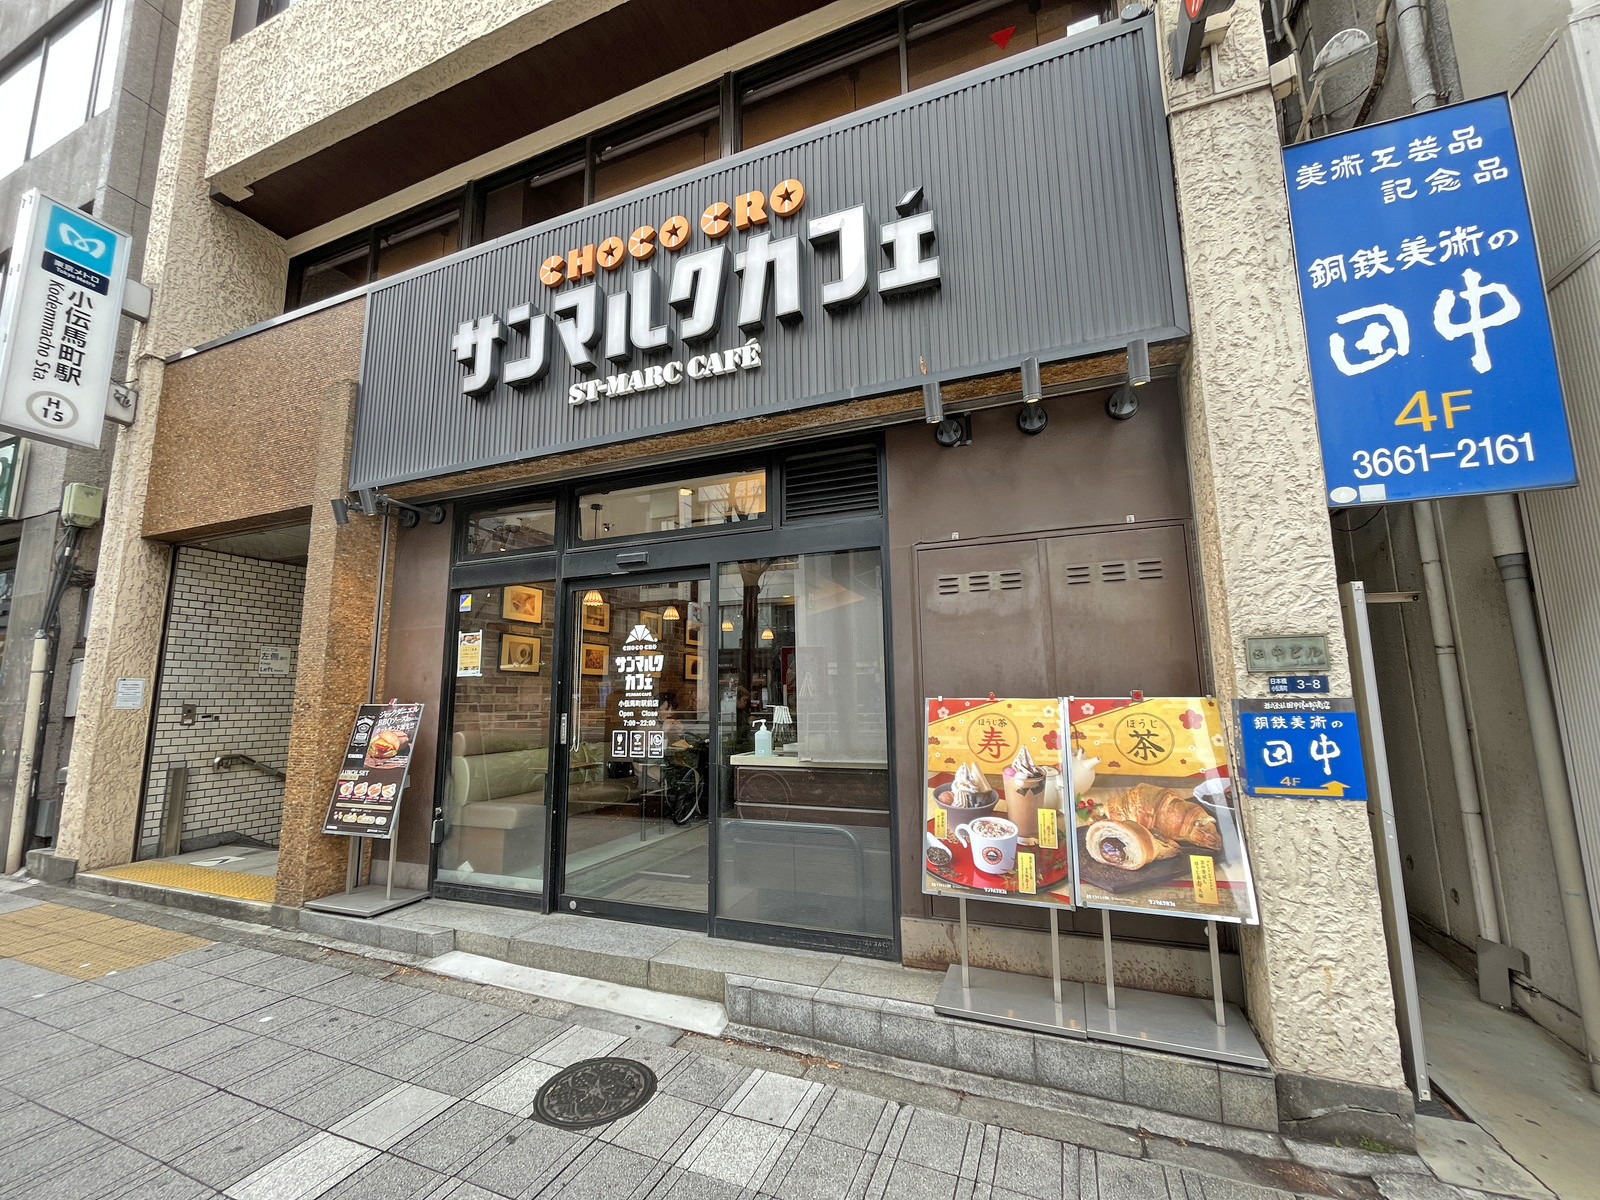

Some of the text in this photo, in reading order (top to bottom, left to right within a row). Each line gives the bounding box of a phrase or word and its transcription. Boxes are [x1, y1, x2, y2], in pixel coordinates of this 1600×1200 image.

[1296, 126, 1483, 190] 美術工芸品
[1381, 157, 1508, 204] 記念品
[539, 178, 806, 288] CHOCO CRO
[53, 259, 100, 284] 東京メトロ
[1307, 225, 1519, 289] 銅鉄美術の
[56, 267, 96, 288] Tokyo Metro
[452, 186, 943, 398] サンマルクカフェ
[32, 279, 65, 381] Kodemmacho Sta.
[54, 291, 93, 386] 小伝馬町駅
[1329, 268, 1521, 376] 田中
[568, 338, 762, 407] ST-MARC CAFÉ
[42, 407, 64, 423] 15
[47, 397, 60, 409] H
[1394, 389, 1473, 432] 4F
[1352, 432, 1535, 479] 3661-2161
[615, 655, 664, 673] サンマルク
[1252, 644, 1323, 662] 田中ビル
[625, 673, 653, 690] カフェ
[1270, 677, 1321, 689] 日本橋 3-8
[618, 710, 634, 718] Open
[978, 718, 1007, 727] ほうじ茶
[1126, 719, 1157, 728] ほうじ
[1254, 715, 1343, 730] 銅鉄美術の
[976, 726, 1010, 759] 寿
[1126, 728, 1166, 761] 茶
[1263, 733, 1341, 776] 田中
[1280, 776, 1300, 786] 4F
